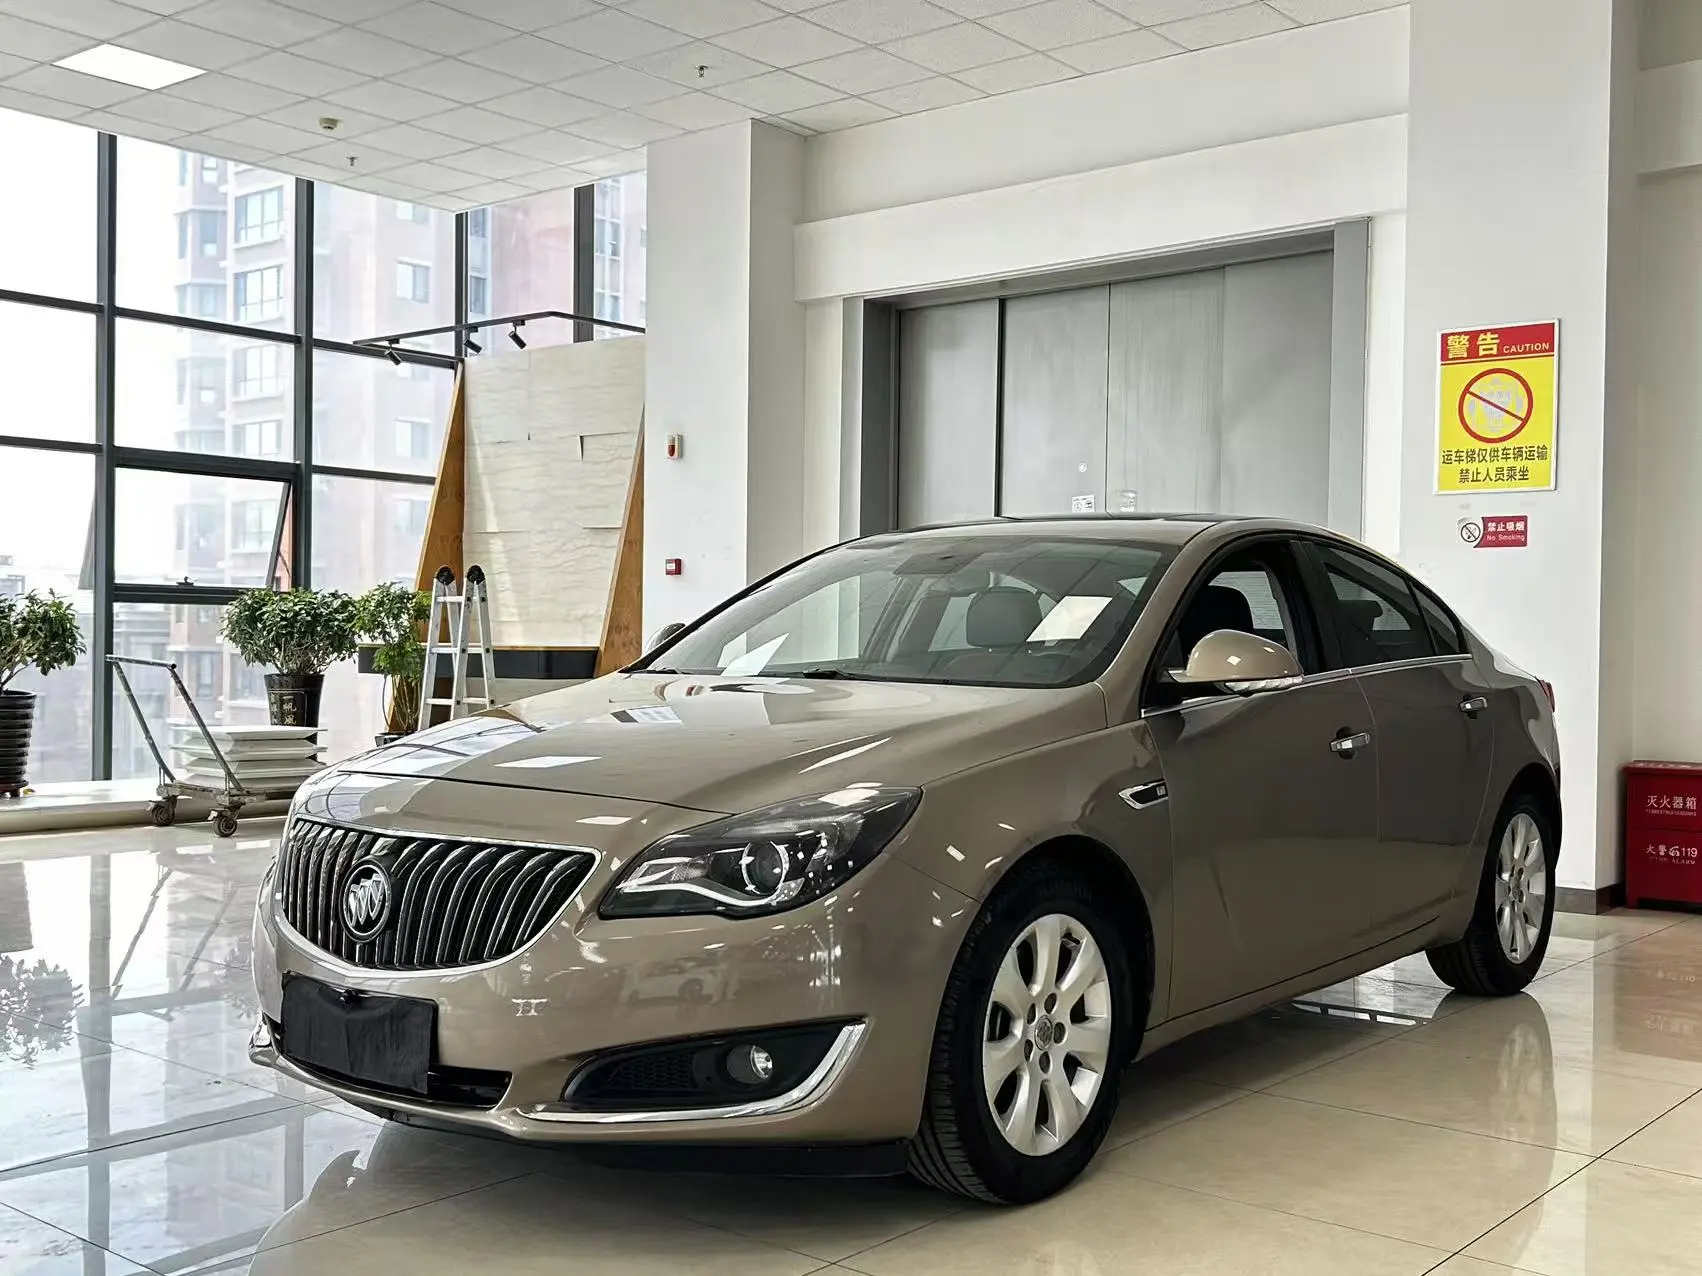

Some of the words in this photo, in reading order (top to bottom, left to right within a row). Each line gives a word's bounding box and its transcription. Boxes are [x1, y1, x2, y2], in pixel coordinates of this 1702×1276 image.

[1447, 332, 1499, 358] 警告
[1503, 342, 1549, 353] CAUTION
[1442, 444, 1548, 465] 运车梯仅供车辆运输
[1459, 465, 1529, 483] 禁止人员乘坐
[1487, 521, 1525, 532] 禁止吸烟
[1647, 795, 1697, 810] 灭火器箱
[1681, 847, 1698, 858] 119
